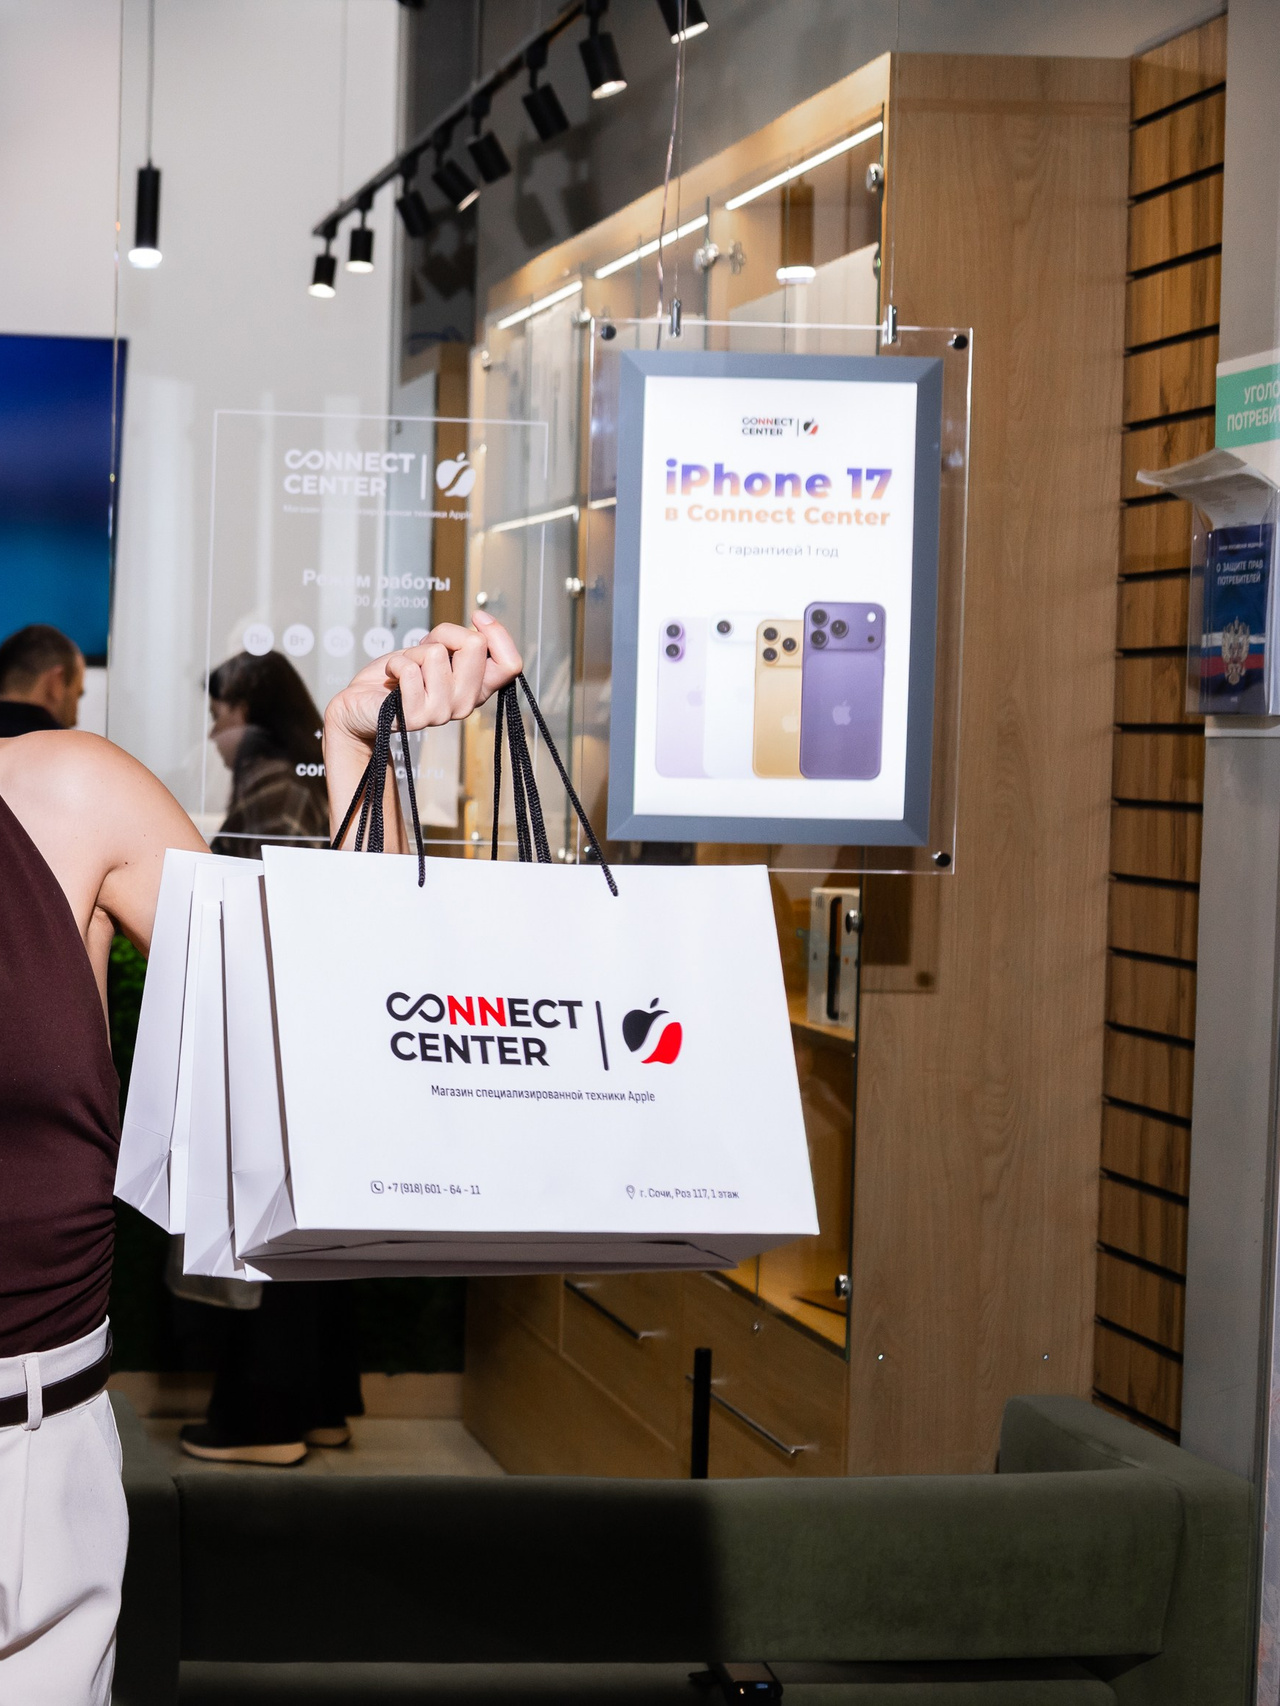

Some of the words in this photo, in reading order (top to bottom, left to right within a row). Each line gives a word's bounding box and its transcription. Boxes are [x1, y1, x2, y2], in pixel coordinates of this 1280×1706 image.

[1244, 380, 1280, 404] УГОЛО
[742, 417, 794, 427] CONNECT
[742, 427, 783, 436] CENTER
[284, 449, 416, 473] CONNECT
[283, 474, 388, 497] CENTER
[666, 458, 833, 498] iPhone
[846, 467, 893, 500] 17
[665, 507, 678, 522] в
[687, 503, 795, 524] Connect
[804, 506, 891, 526] Center
[729, 544, 803, 558] гарантией
[815, 548, 839, 559] год
[377, 572, 451, 591] работы
[386, 991, 583, 1030] CONNECT
[390, 1030, 550, 1067] CENTER
[431, 1085, 473, 1098] Магазин
[475, 1087, 584, 1102] специализированной
[585, 1090, 626, 1101] техники
[628, 1091, 656, 1104] Apple
[400, 1182, 424, 1195] (918)
[424, 1184, 441, 1194] 601
[449, 1184, 462, 1194] 64
[470, 1185, 481, 1195] 11
[648, 1188, 674, 1199] Сочи,
[675, 1188, 691, 1198] Роз
[693, 1188, 710, 1200] 117,
[718, 1190, 740, 1199] этаж
